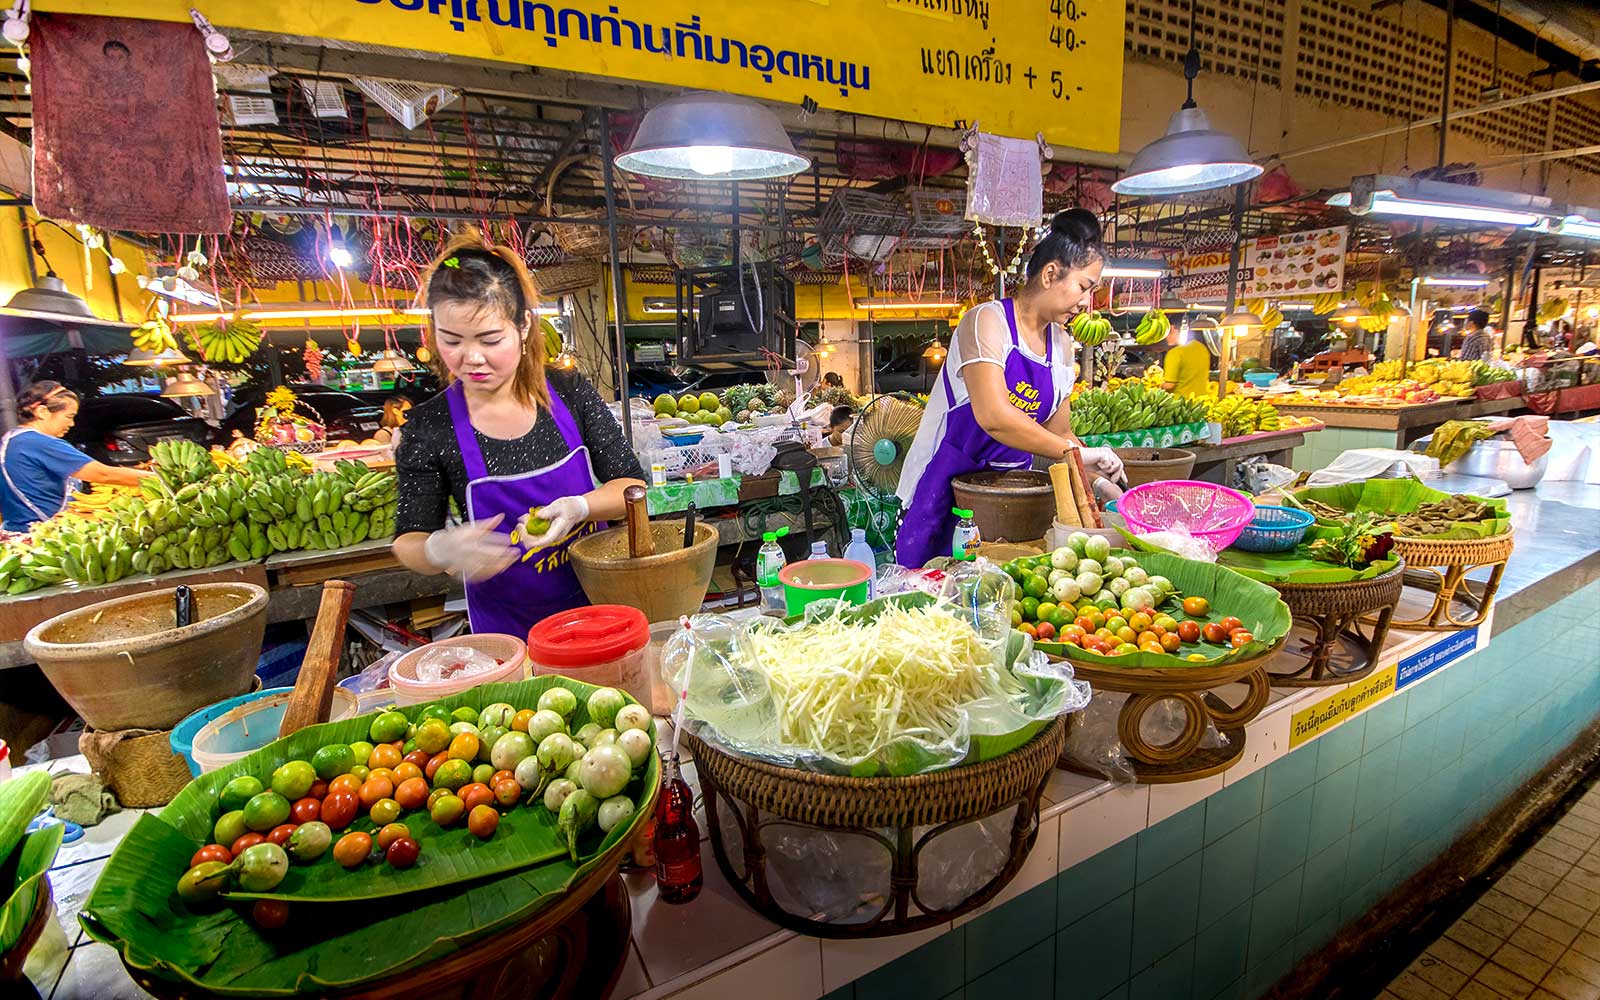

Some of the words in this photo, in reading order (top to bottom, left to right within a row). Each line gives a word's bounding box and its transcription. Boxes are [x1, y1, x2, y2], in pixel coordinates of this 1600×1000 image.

[355, 0, 871, 97] คุณทุกท่านที่มาอุดหนุน
[921, 37, 1011, 84] แยกเครื่อง
